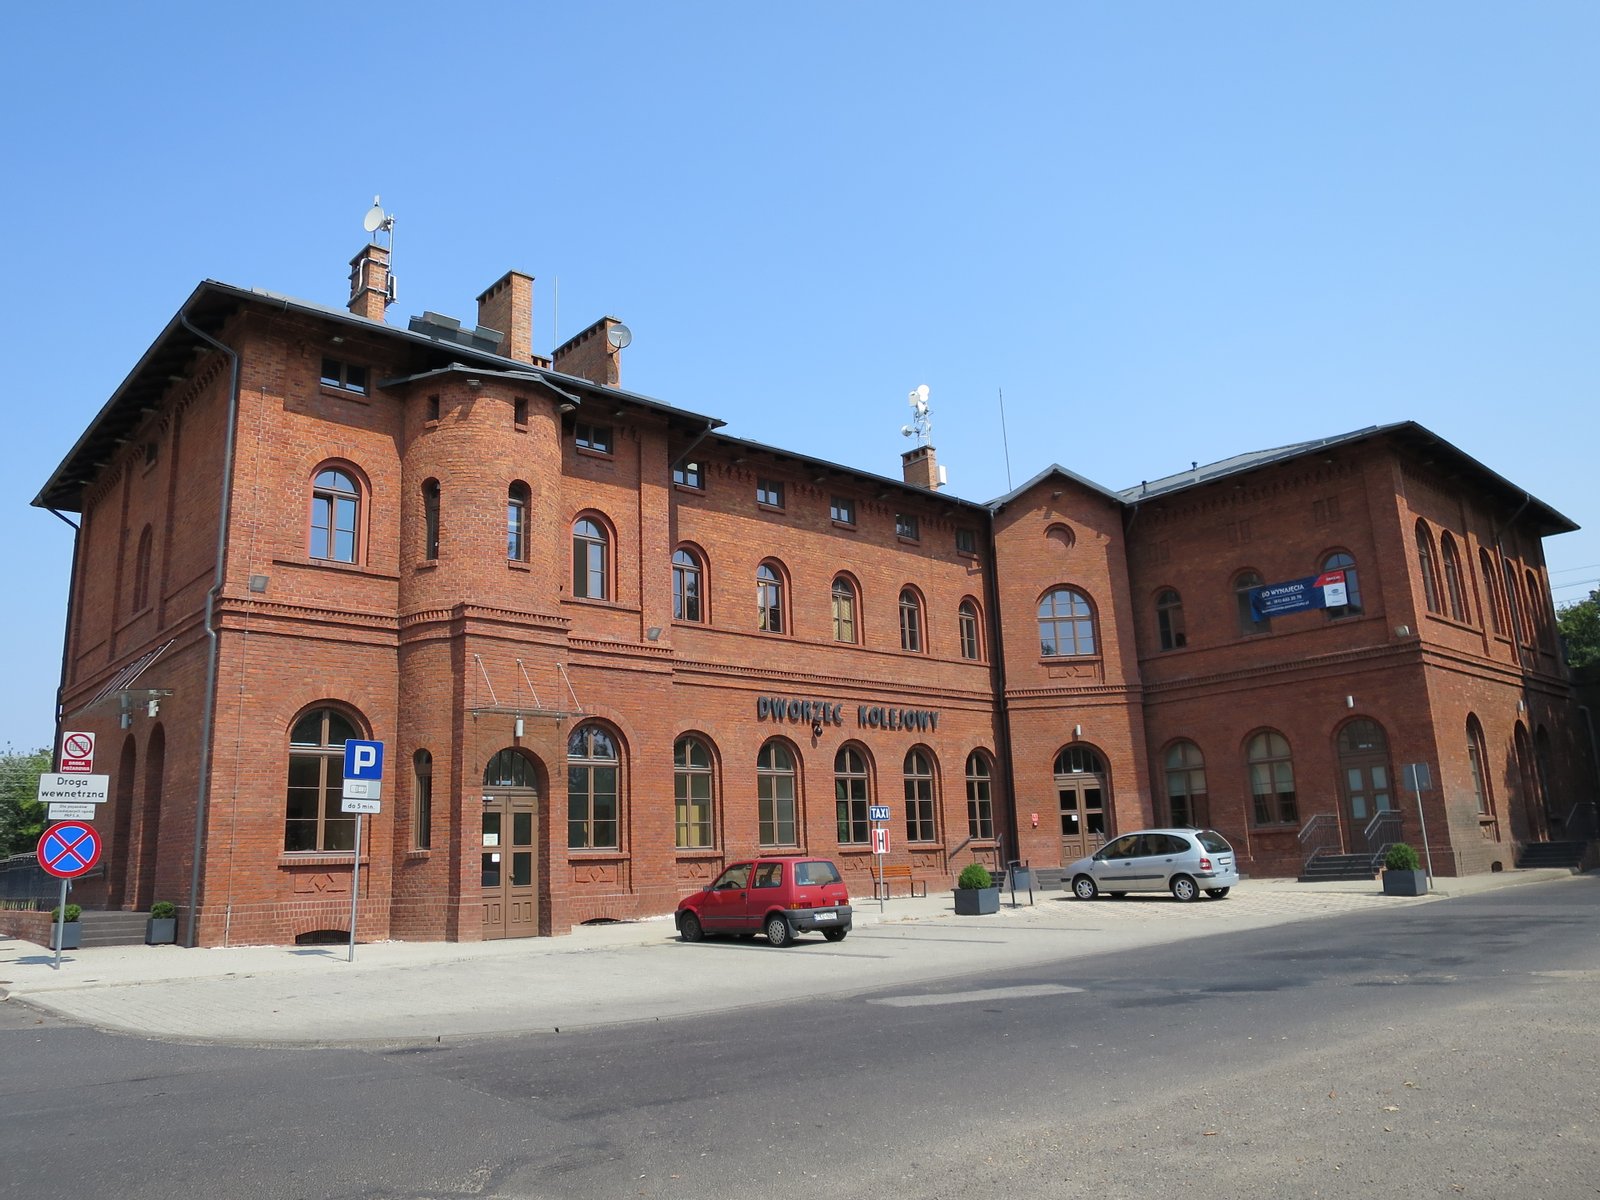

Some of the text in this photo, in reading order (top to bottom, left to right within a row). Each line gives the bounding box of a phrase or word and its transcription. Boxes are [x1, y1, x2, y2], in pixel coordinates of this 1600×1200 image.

[1271, 584, 1304, 595] WYNAJĘCIA
[757, 696, 940, 732] DWORZEC KOLEJOWY
[353, 745, 376, 775] P
[57, 777, 88, 788] Droga
[871, 808, 888, 818] TAXI
